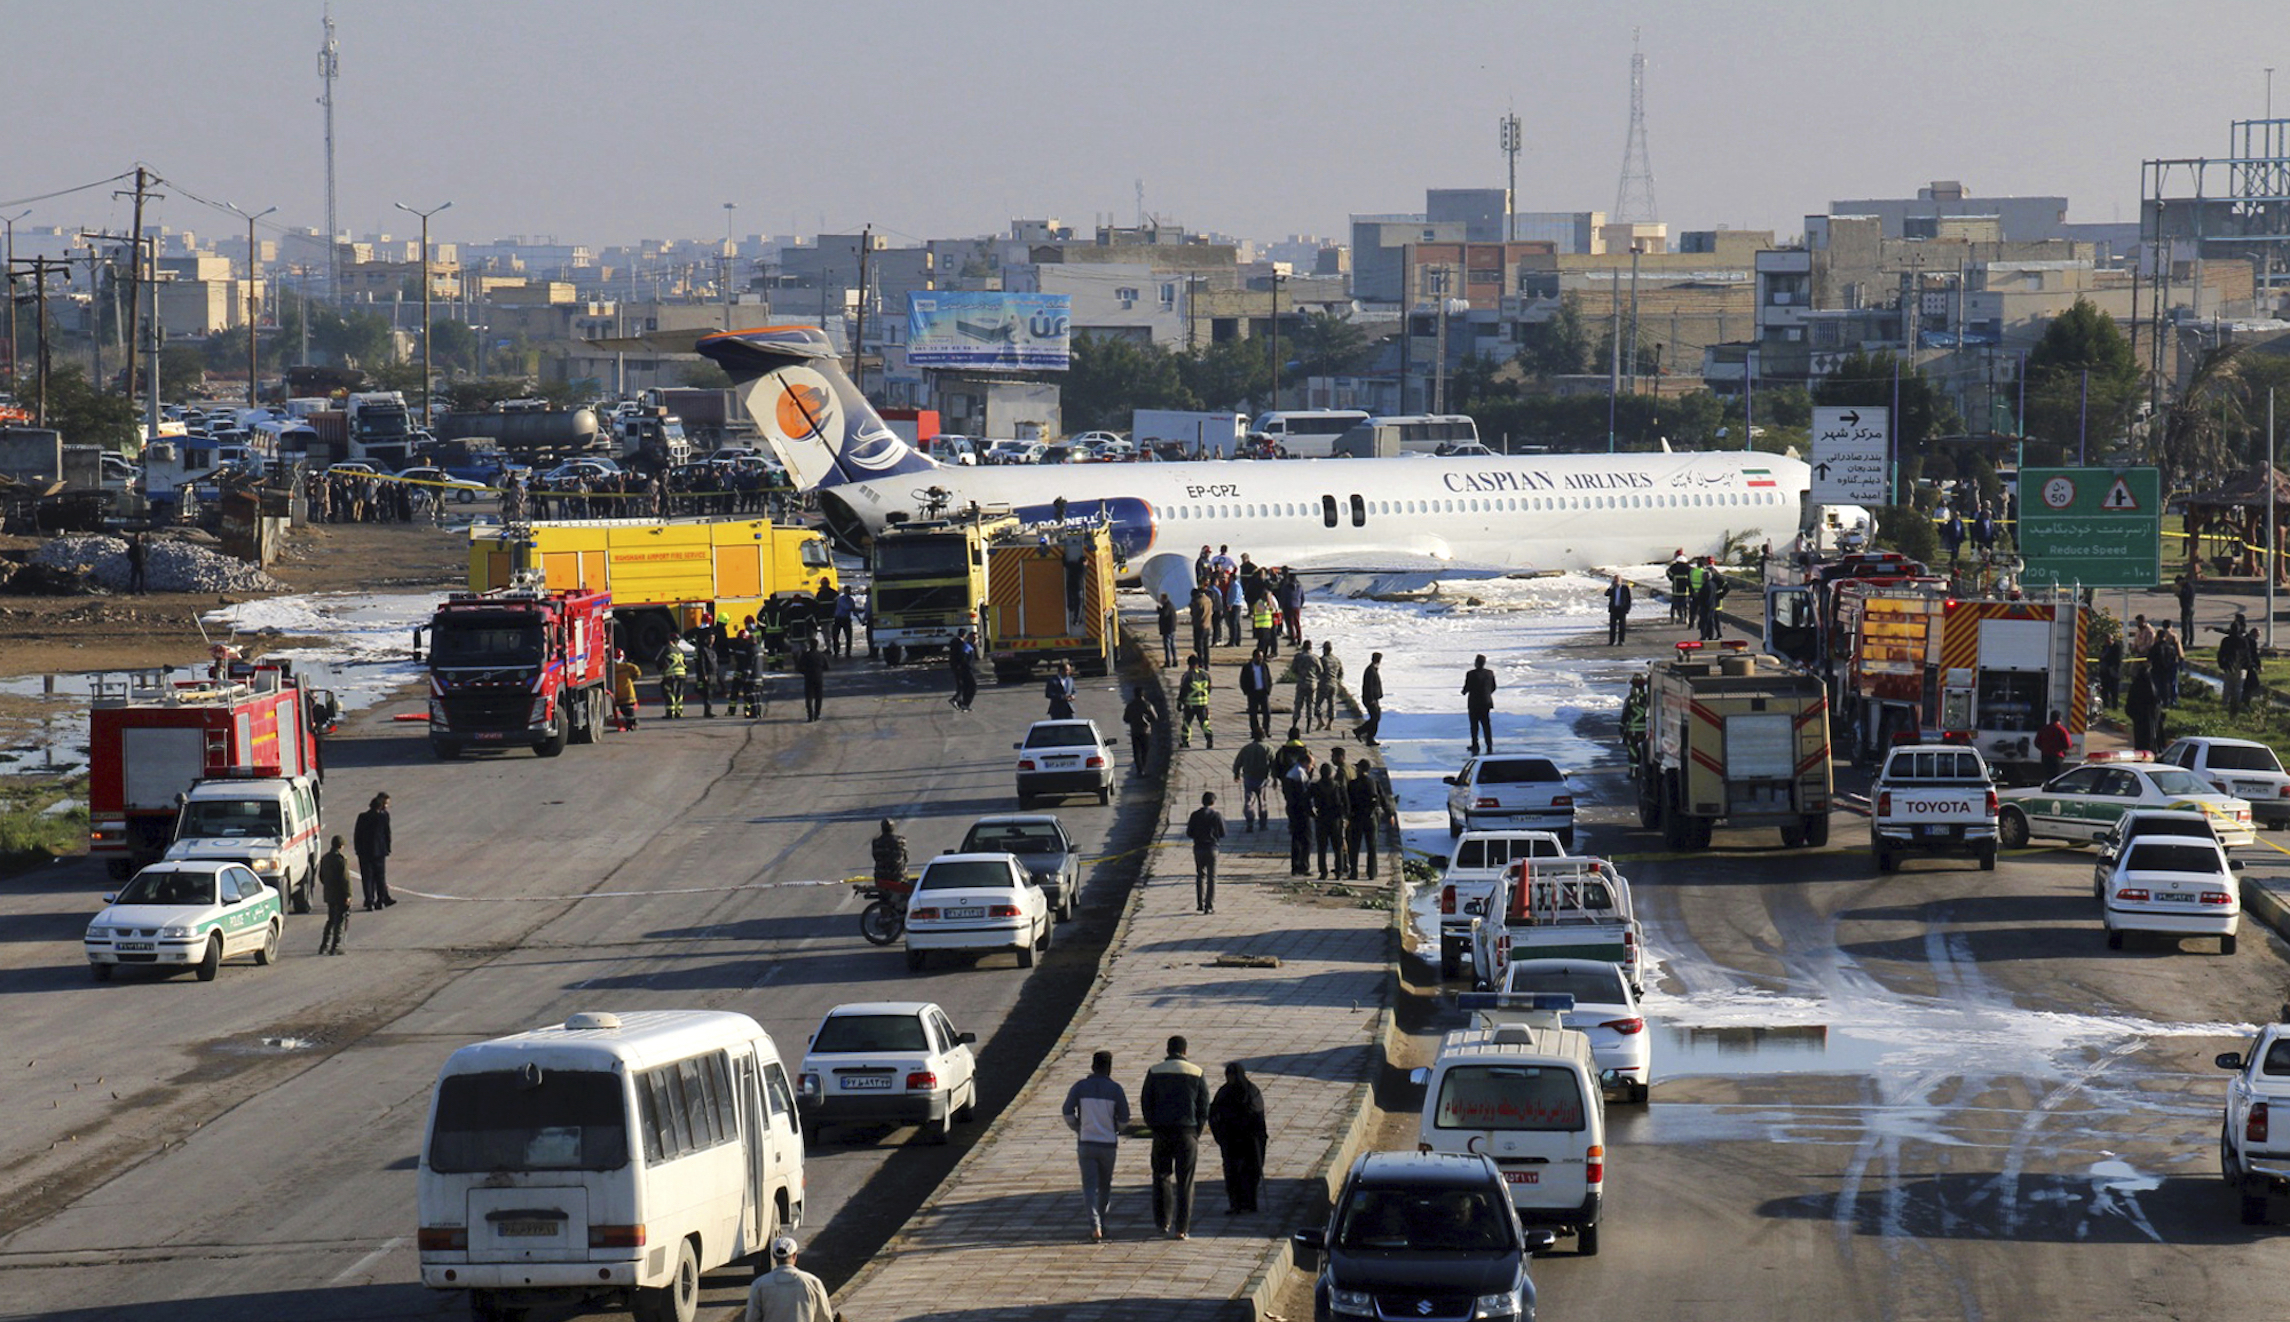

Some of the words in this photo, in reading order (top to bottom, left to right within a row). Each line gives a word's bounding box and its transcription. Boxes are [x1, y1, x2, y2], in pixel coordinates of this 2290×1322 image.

[1820, 427, 1849, 442] شهر
[1851, 428, 1883, 441] مرکز
[1847, 464, 1882, 474] هندیجان
[1443, 470, 1555, 493] CASPIAN
[1564, 472, 1653, 489] AIRLINES
[2052, 482, 2065, 492] ۵۰
[1186, 484, 1241, 498] EP-CPZ
[1849, 491, 1881, 500] امیدیه
[2051, 493, 2066, 503] 50
[647, 552, 670, 560] AIRPORT
[684, 551, 706, 559] SERVICE
[2050, 544, 2090, 555] Reduce
[2092, 544, 2128, 556] Speed
[1906, 801, 1971, 813] TOYOTA
